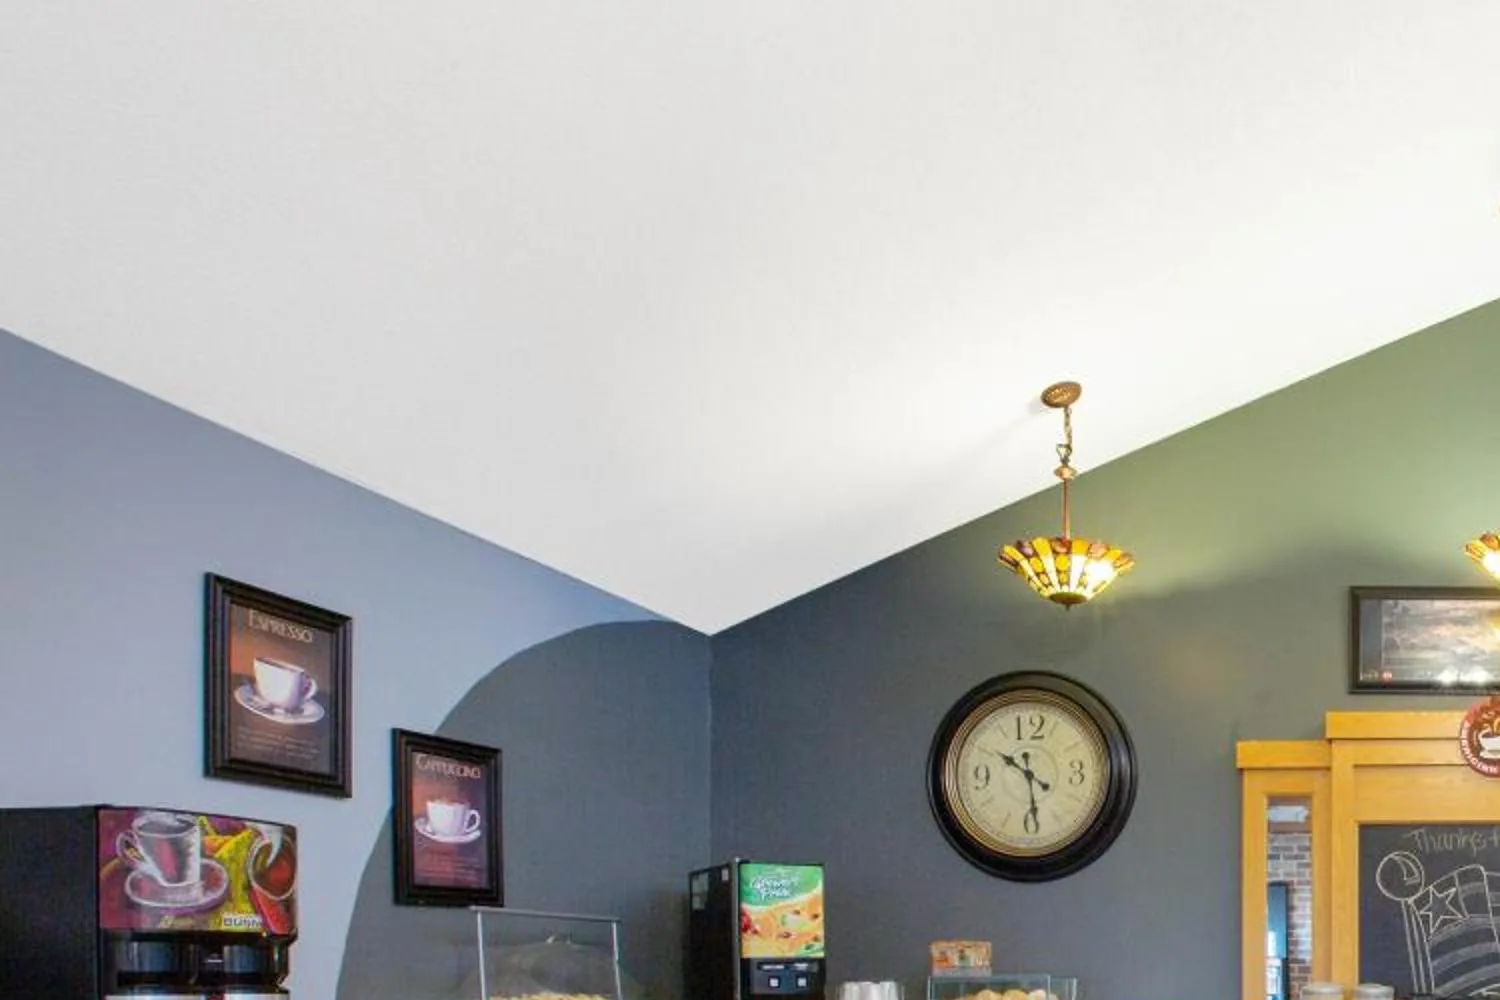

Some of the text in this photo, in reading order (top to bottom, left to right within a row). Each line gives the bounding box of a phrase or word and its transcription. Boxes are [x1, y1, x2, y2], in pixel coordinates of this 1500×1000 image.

[1014, 715, 1046, 741] 12
[973, 764, 991, 791] 9
[1068, 760, 1085, 786] 3
